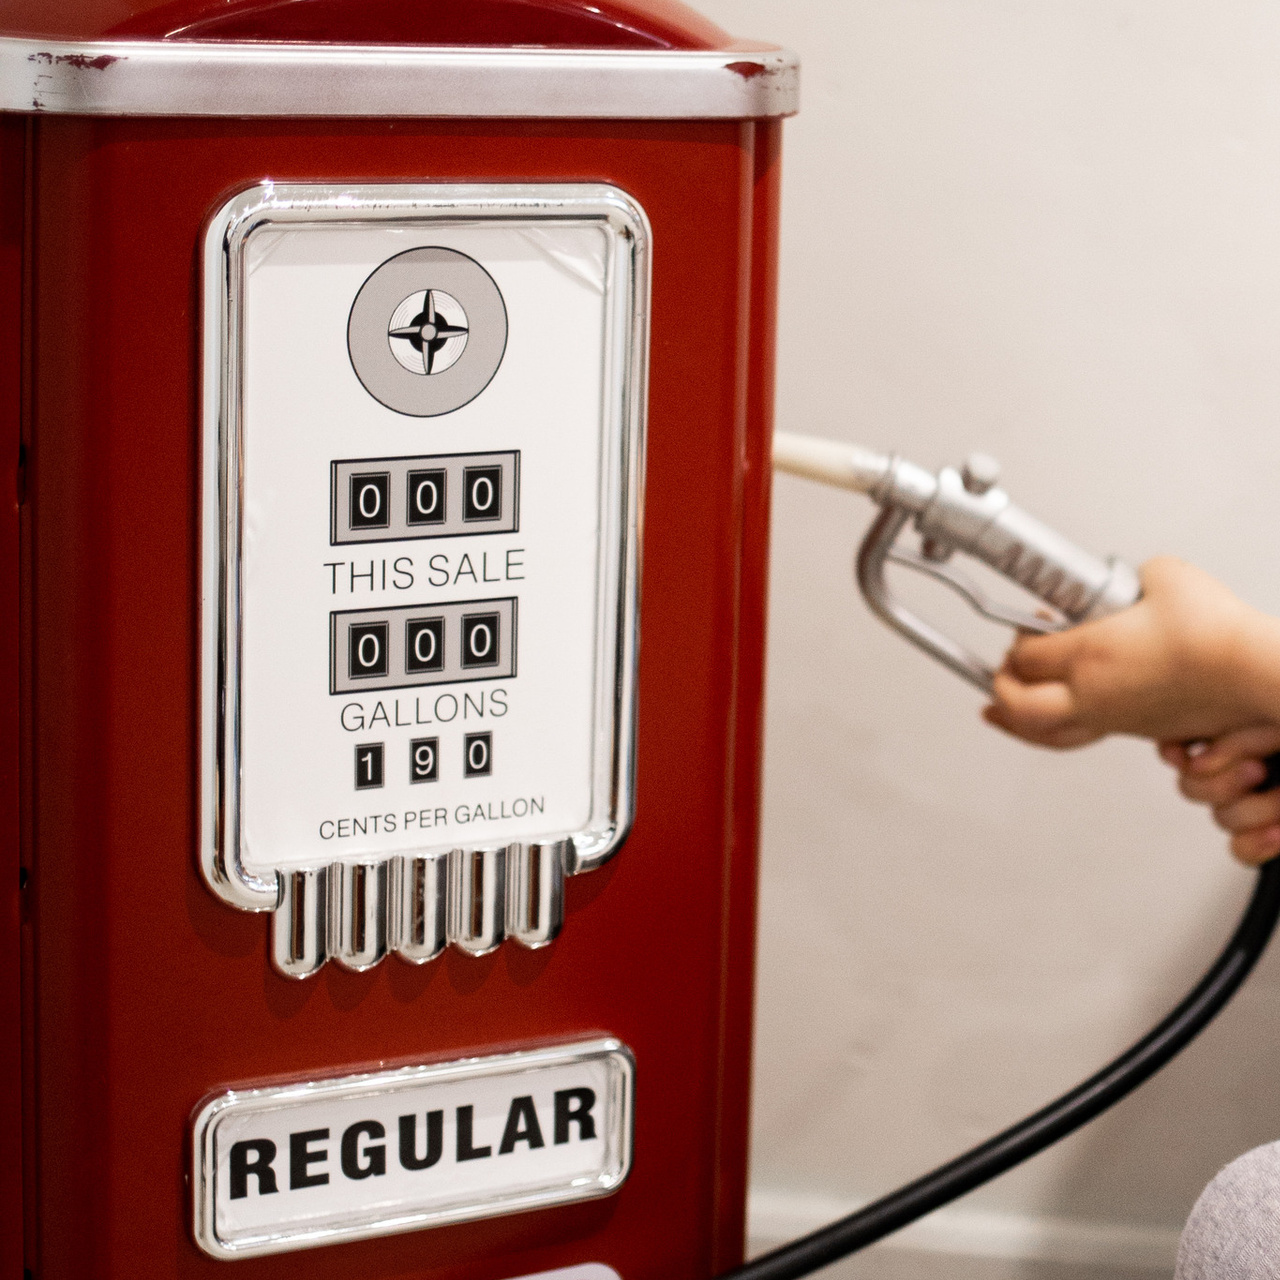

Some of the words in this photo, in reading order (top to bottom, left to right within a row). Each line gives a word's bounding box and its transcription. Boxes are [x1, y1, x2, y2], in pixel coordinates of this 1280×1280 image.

[323, 557, 415, 594] THIS
[428, 549, 525, 587] SALE
[340, 689, 509, 732] GALLONS
[319, 813, 397, 840] CENTS
[404, 808, 448, 830] PER
[454, 796, 545, 824] GALLON
[229, 1087, 598, 1200] REGULAR
